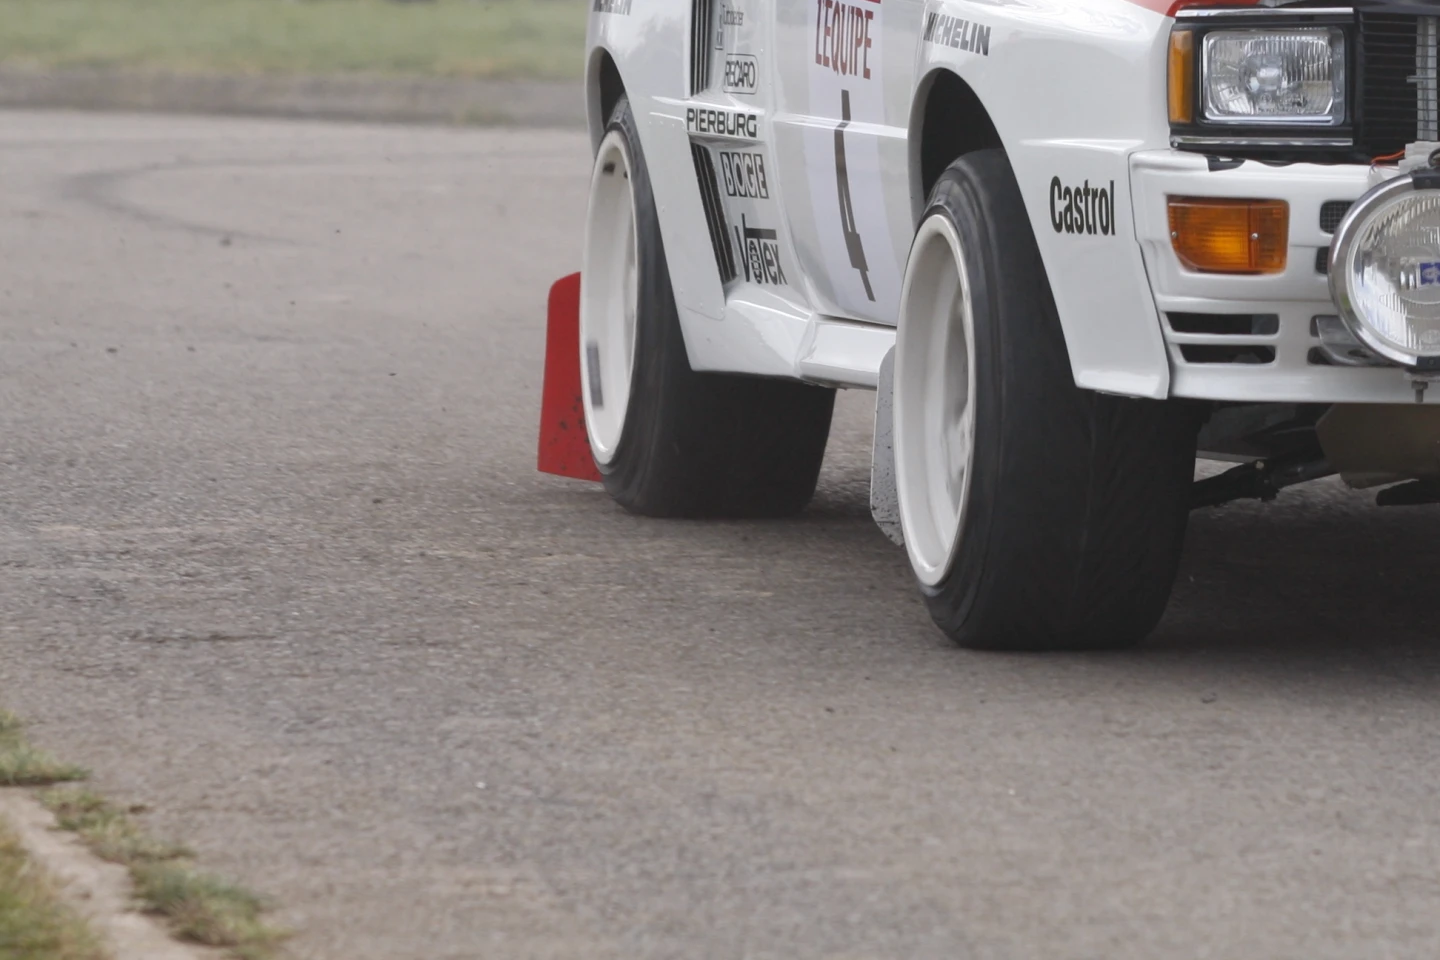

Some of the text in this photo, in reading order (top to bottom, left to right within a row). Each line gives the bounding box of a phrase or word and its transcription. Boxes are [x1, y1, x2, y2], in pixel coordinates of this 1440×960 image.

[922, 11, 992, 57] MICHELIN
[725, 60, 756, 88] RECARO
[686, 107, 758, 138] PIERBURG
[720, 151, 770, 200] BOGE
[1049, 176, 1116, 237] Castrol
